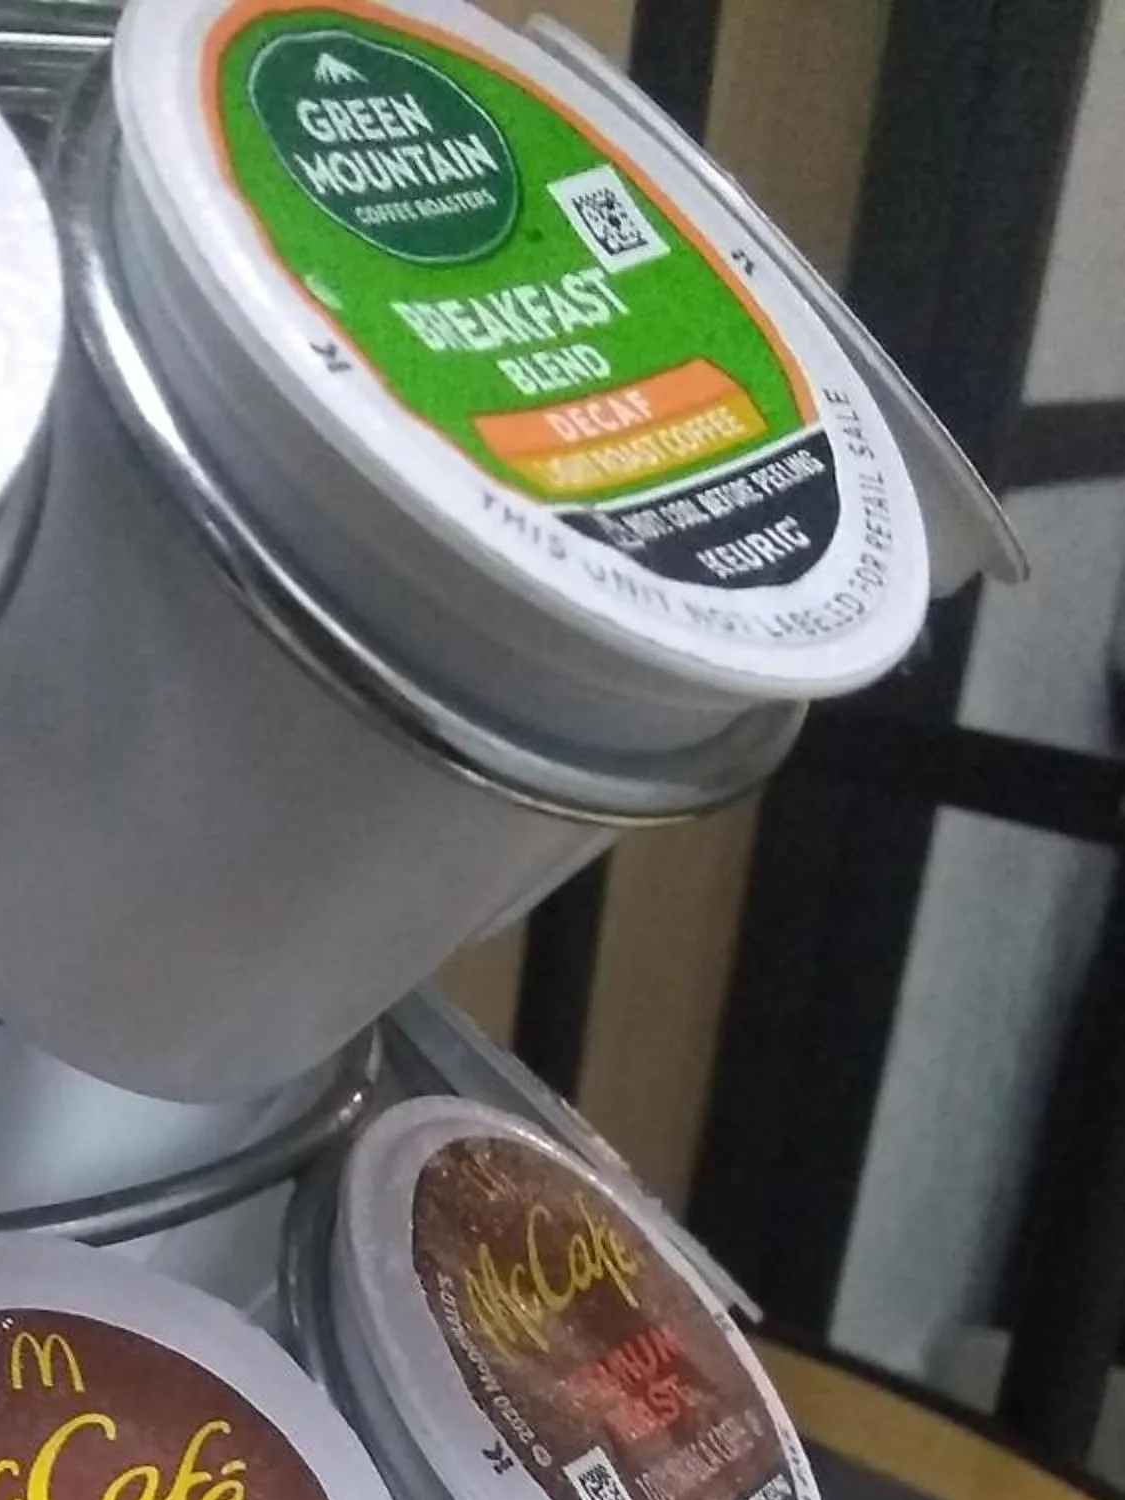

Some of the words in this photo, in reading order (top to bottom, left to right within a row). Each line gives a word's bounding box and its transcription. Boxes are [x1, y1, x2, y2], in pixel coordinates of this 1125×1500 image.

[296, 92, 434, 143] GREEN
[293, 133, 501, 196] MOUNTAIN
[354, 200, 419, 227] COFFEE
[414, 187, 498, 221] ROASTERS
[390, 268, 630, 353] BREAKFAST
[495, 342, 612, 396] BLEND
[544, 388, 653, 443] DECAF
[656, 404, 747, 459] COFFEE
[823, 386, 877, 461] SALE
[748, 448, 825, 497] PEELING
[696, 515, 812, 580] KEURIG
